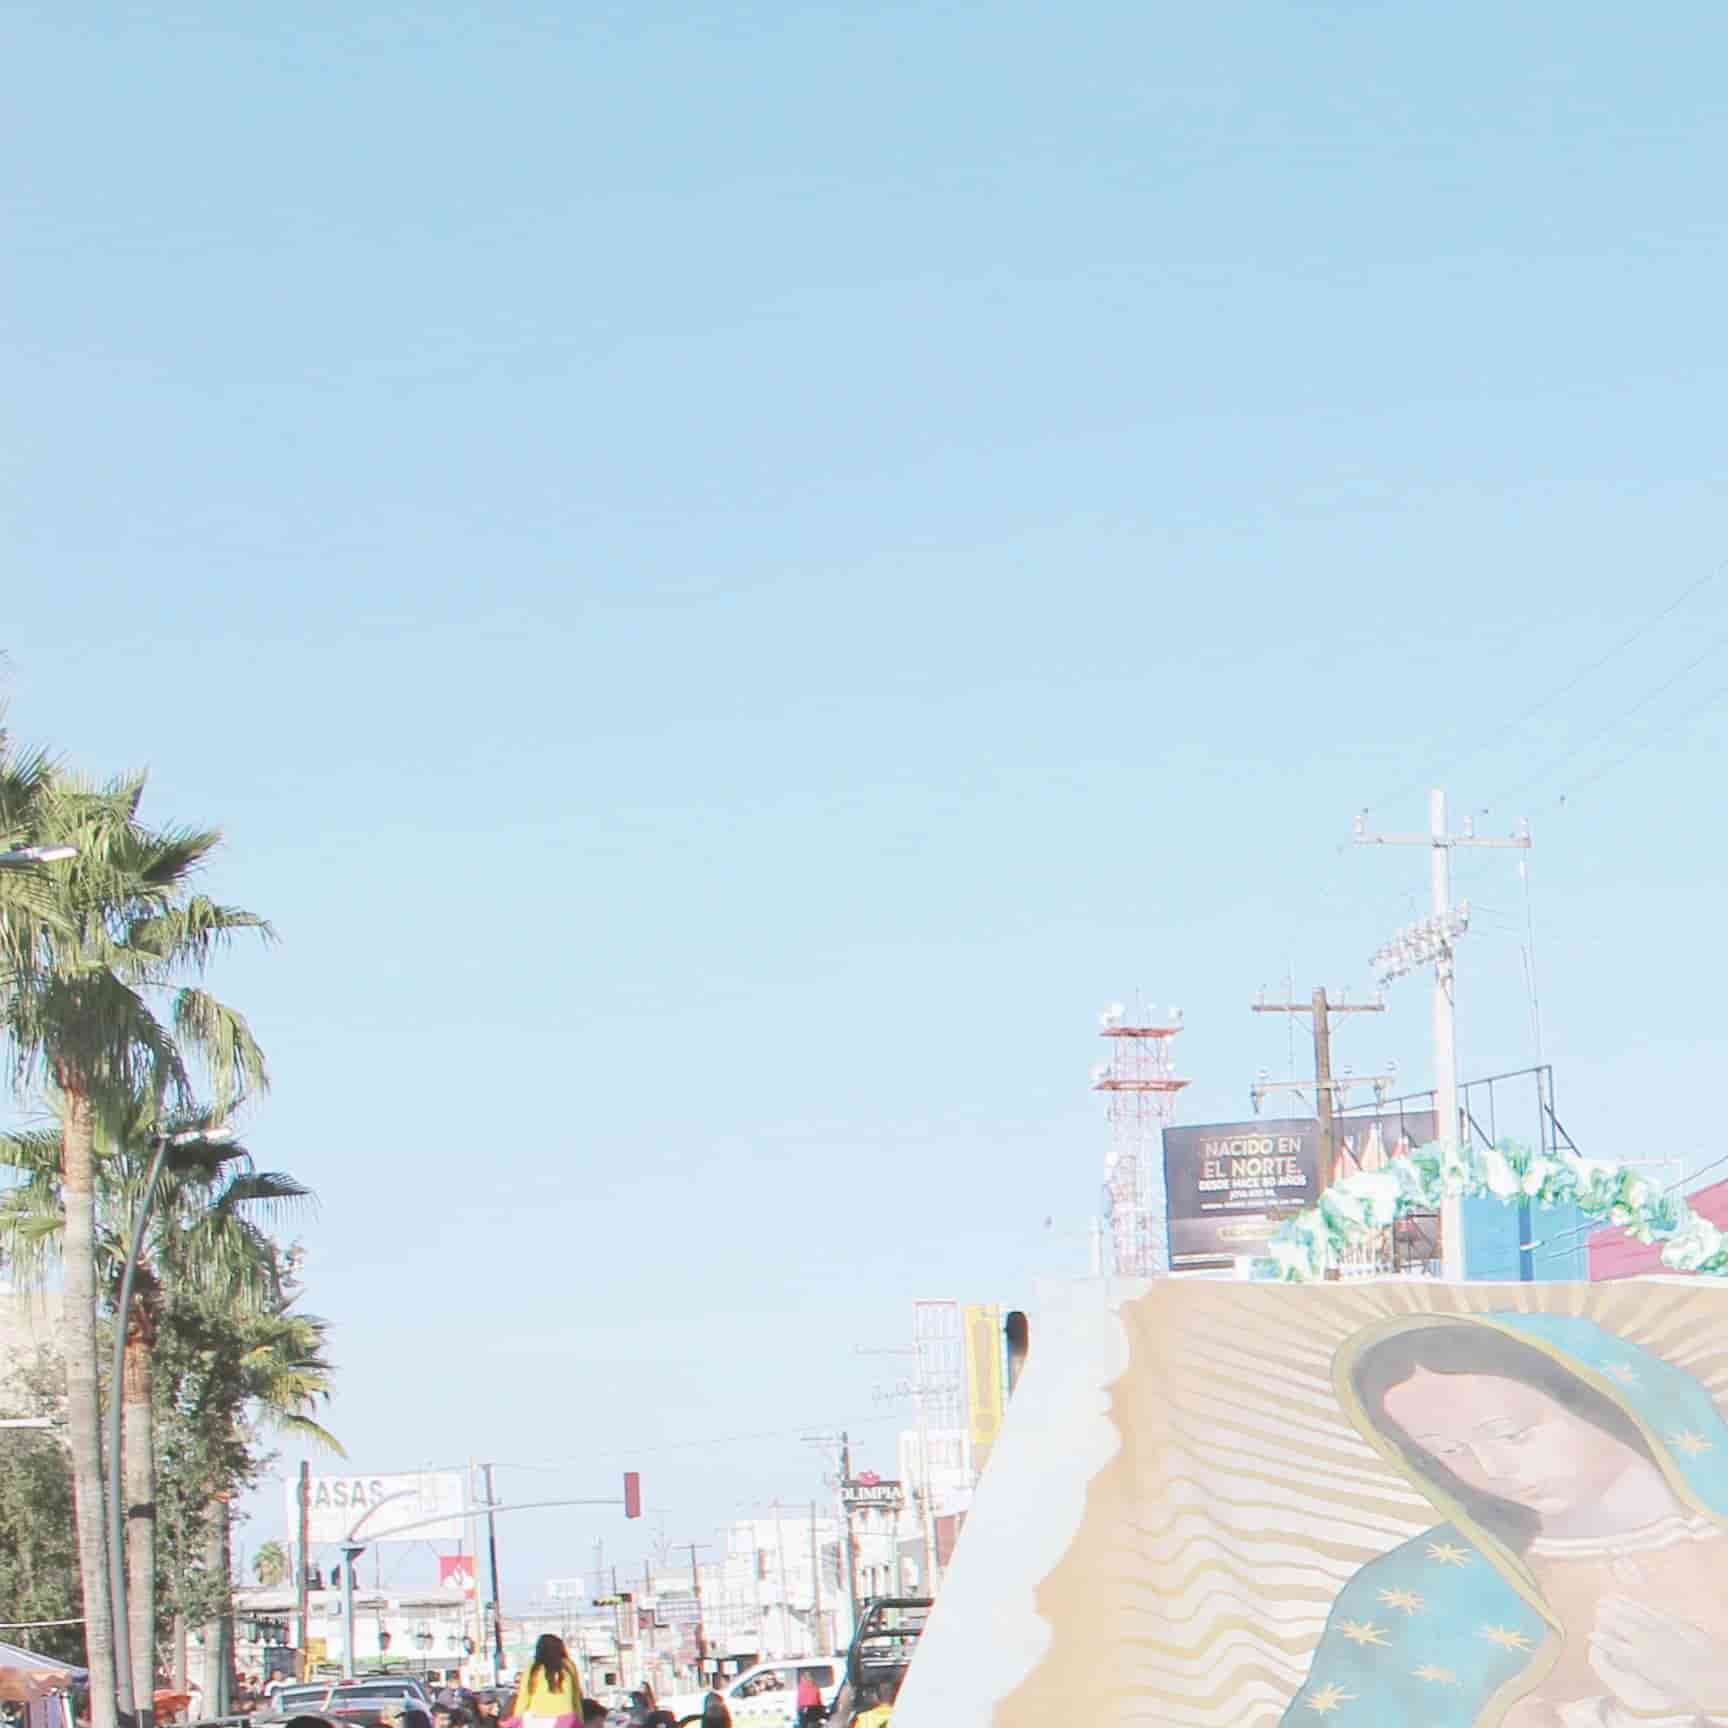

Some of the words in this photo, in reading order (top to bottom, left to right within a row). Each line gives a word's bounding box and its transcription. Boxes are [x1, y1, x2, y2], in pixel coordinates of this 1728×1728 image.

[1205, 1139, 1273, 1157] NACIDO
[1278, 1136, 1301, 1153] EN
[1204, 1160, 1227, 1178] EL
[1231, 1157, 1302, 1178] NORTE.
[841, 1487, 902, 1500] OLIMPIA
